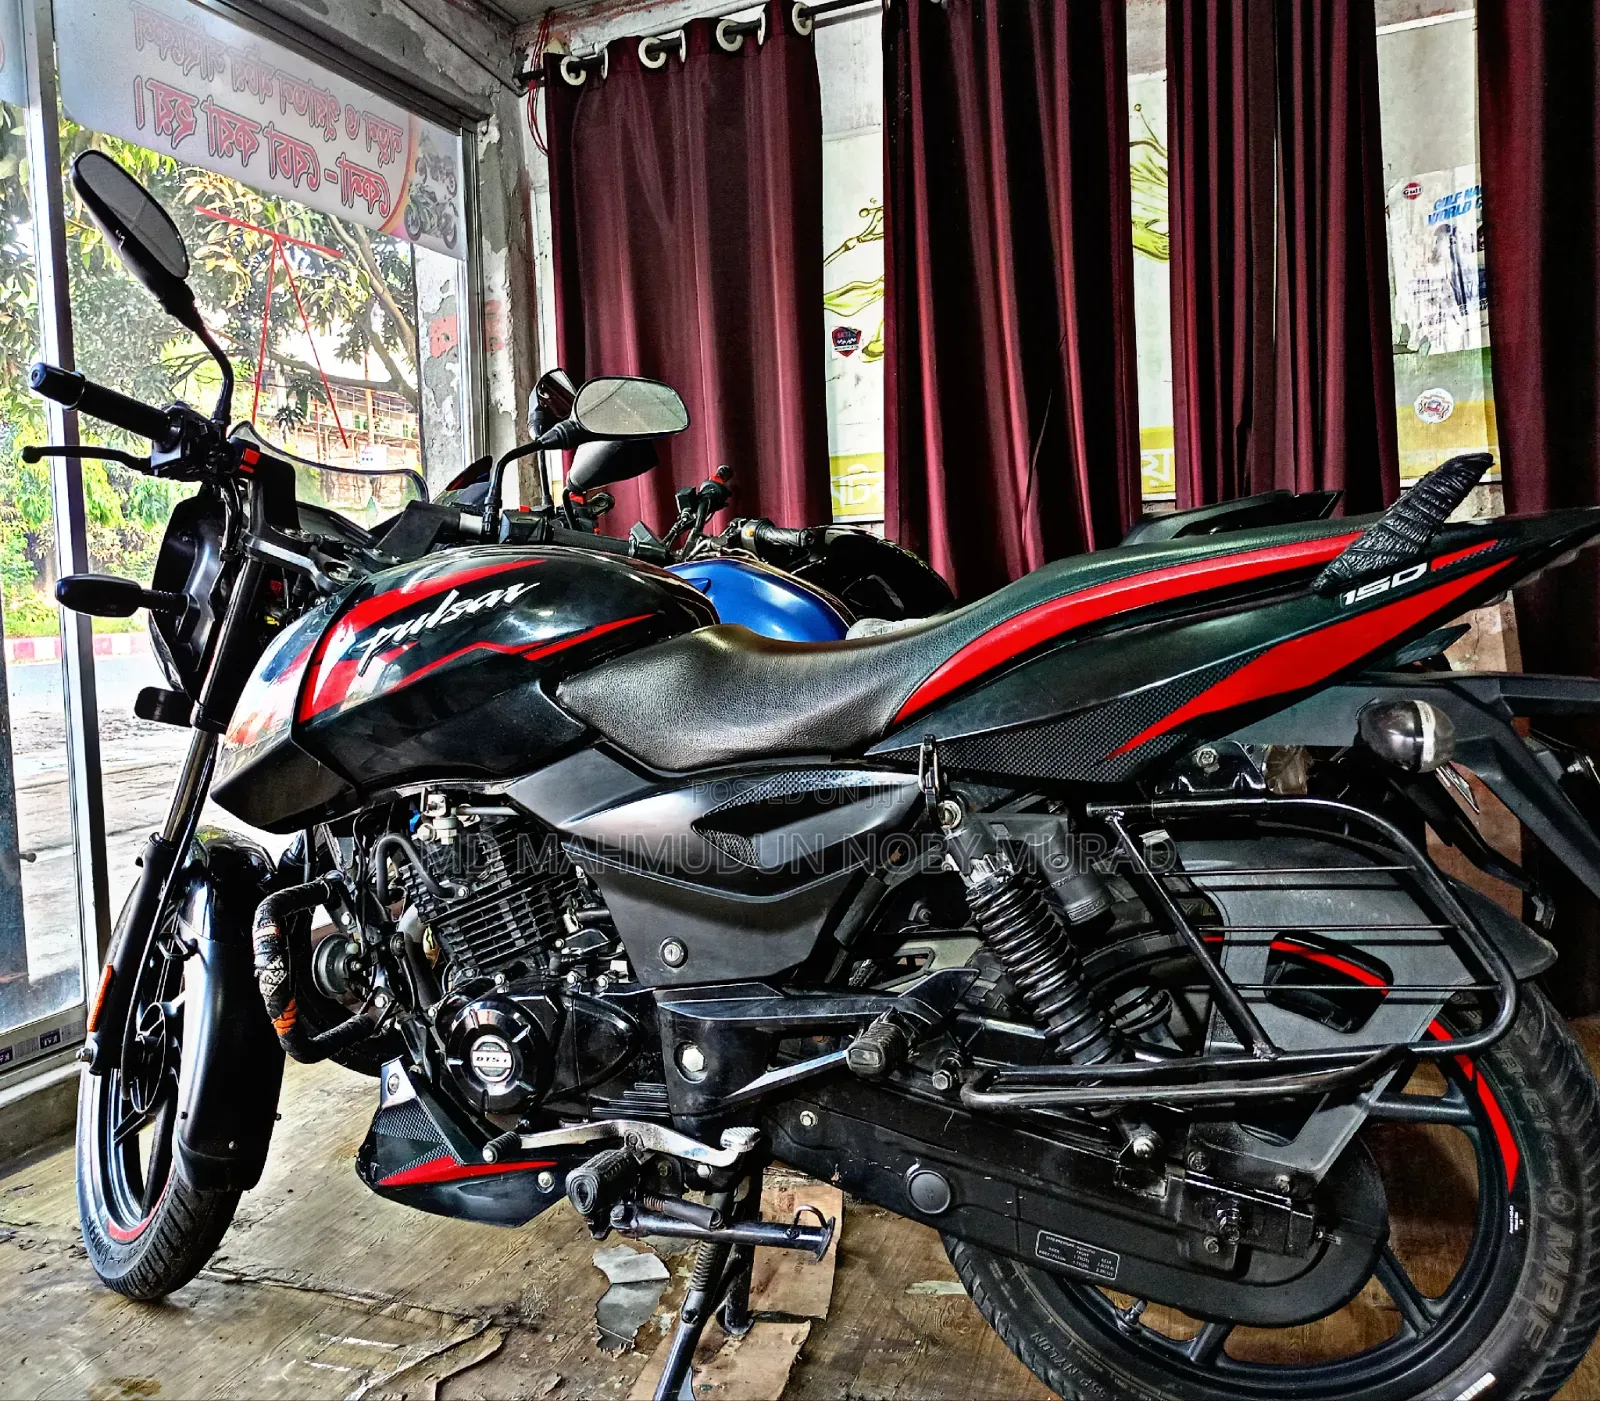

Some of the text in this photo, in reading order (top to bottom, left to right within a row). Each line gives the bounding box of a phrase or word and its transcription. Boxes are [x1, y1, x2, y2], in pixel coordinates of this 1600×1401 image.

[1427, 201, 1472, 226] WORLD
[1343, 562, 1428, 606] 150
[1523, 1221, 1576, 1352] MRF
[1030, 1331, 1080, 1376] NYLON
